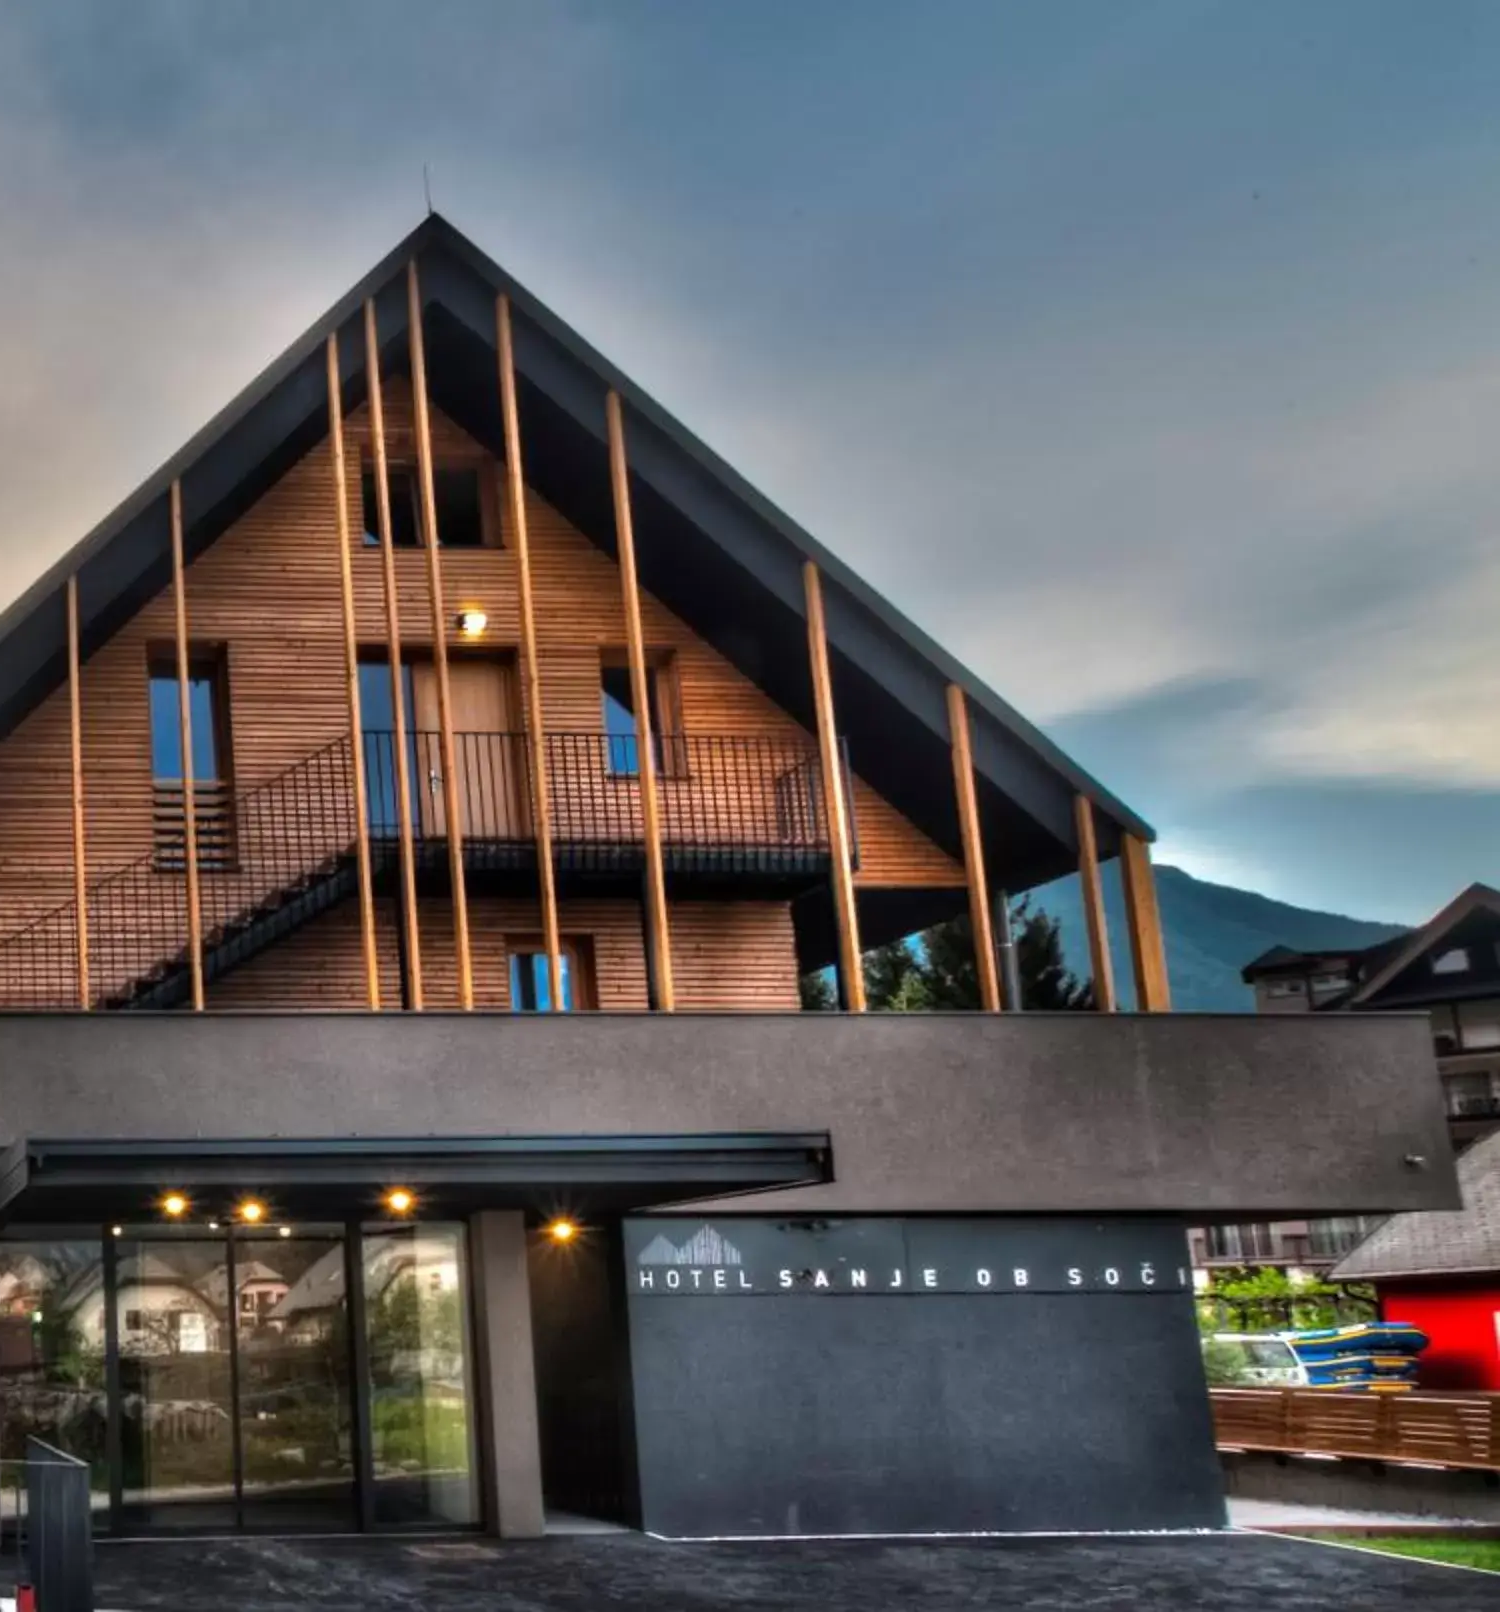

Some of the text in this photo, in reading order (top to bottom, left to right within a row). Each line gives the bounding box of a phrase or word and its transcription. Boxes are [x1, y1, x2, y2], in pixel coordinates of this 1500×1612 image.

[639, 1261, 1186, 1288] HOTEL SANJE OB SOČI
